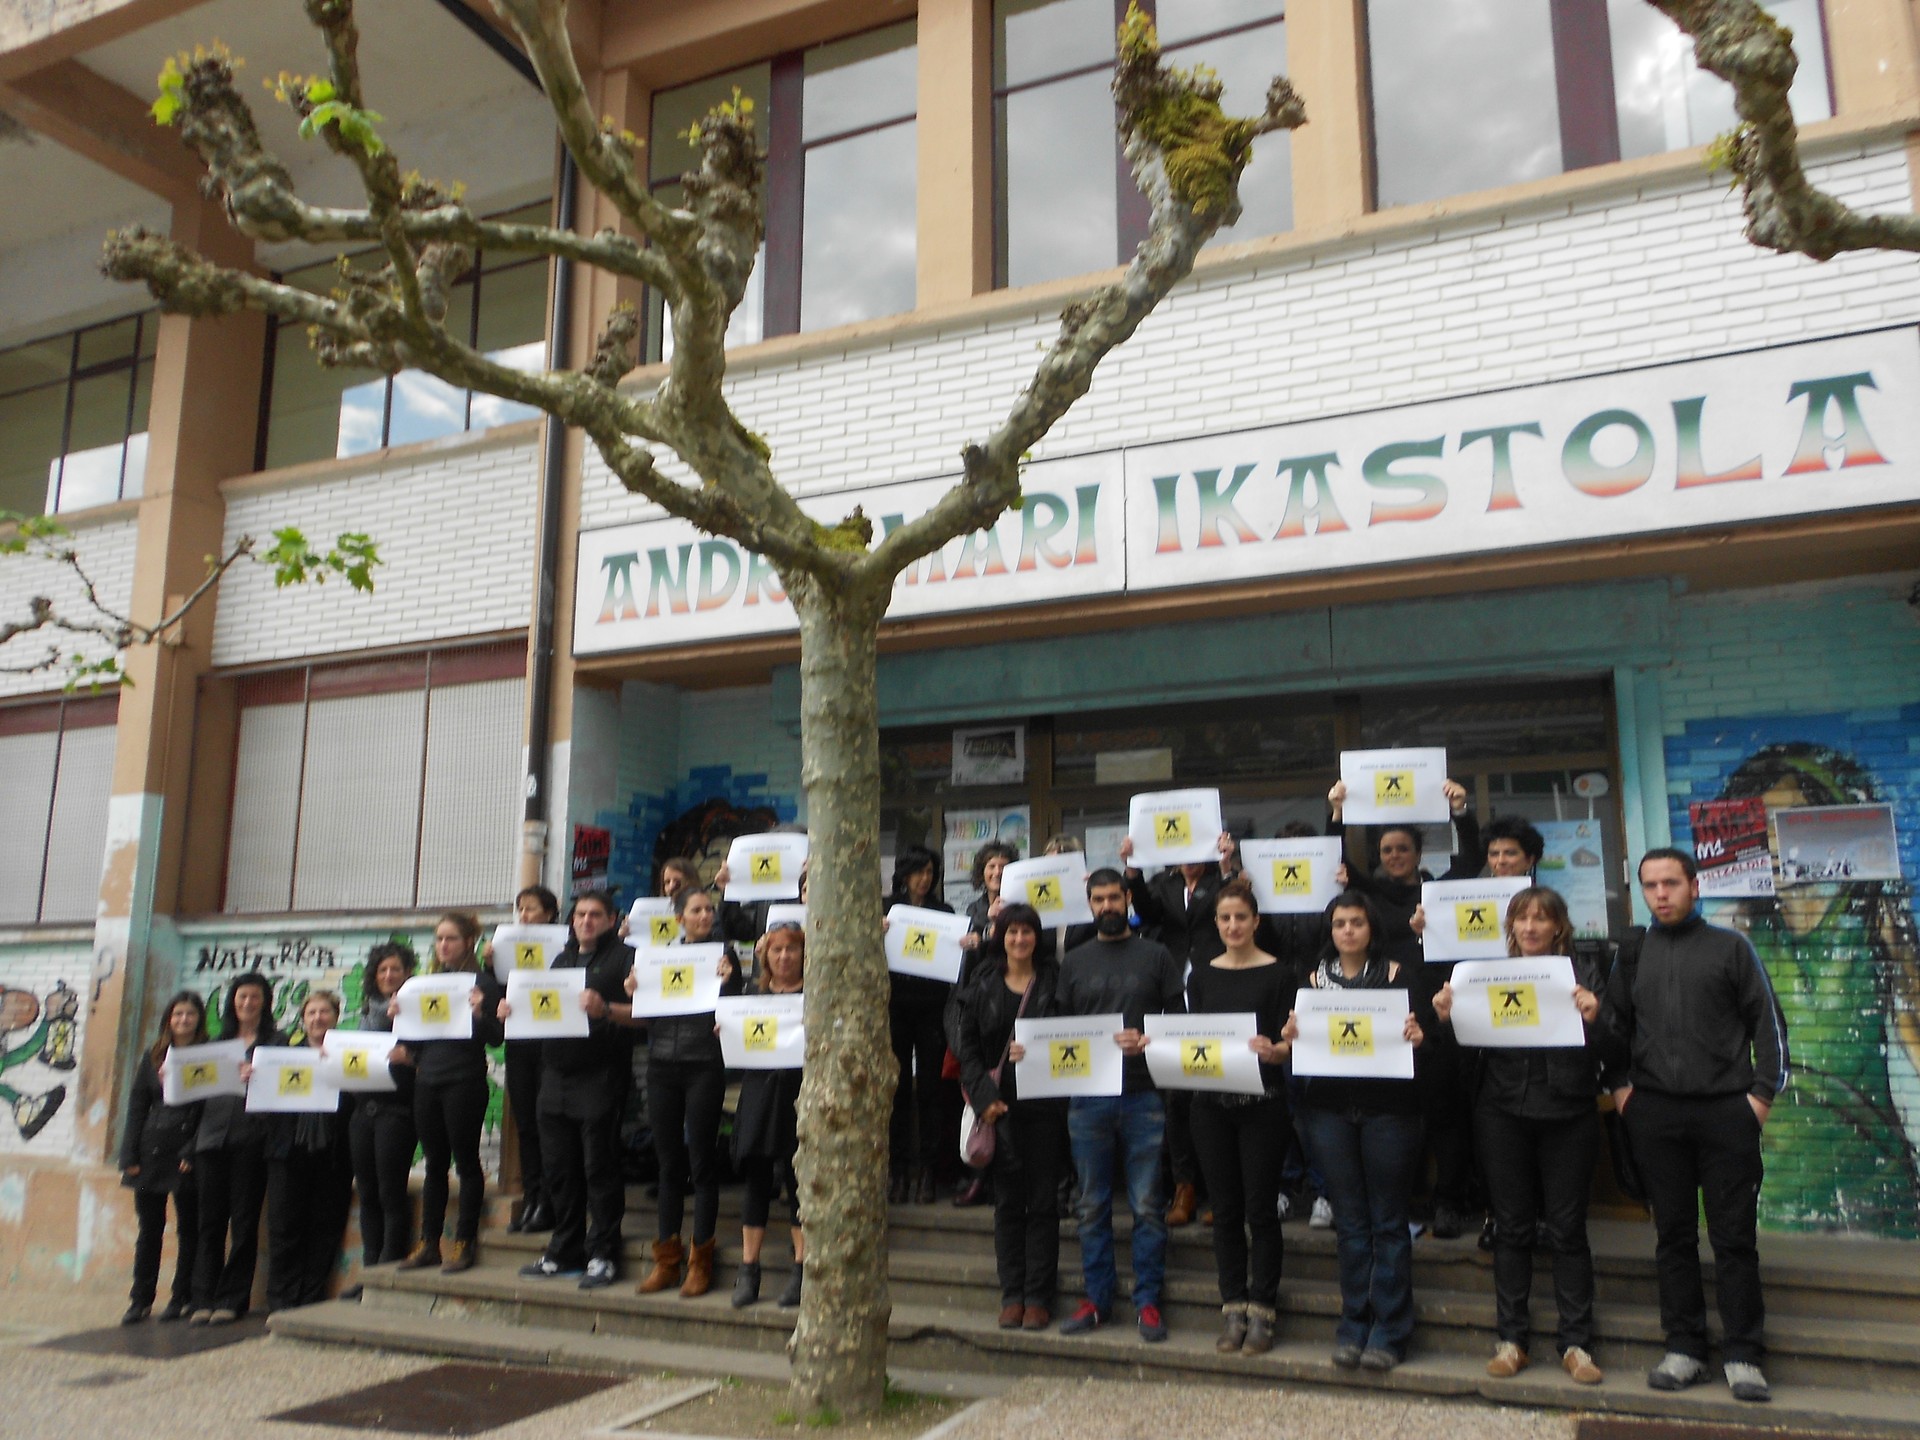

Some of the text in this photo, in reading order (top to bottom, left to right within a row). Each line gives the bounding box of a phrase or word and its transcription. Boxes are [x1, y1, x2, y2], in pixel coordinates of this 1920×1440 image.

[597, 524, 837, 623] ANDR
[1152, 372, 1891, 554] IKASTOLA
[1493, 1009, 1536, 1018] LOMCE
